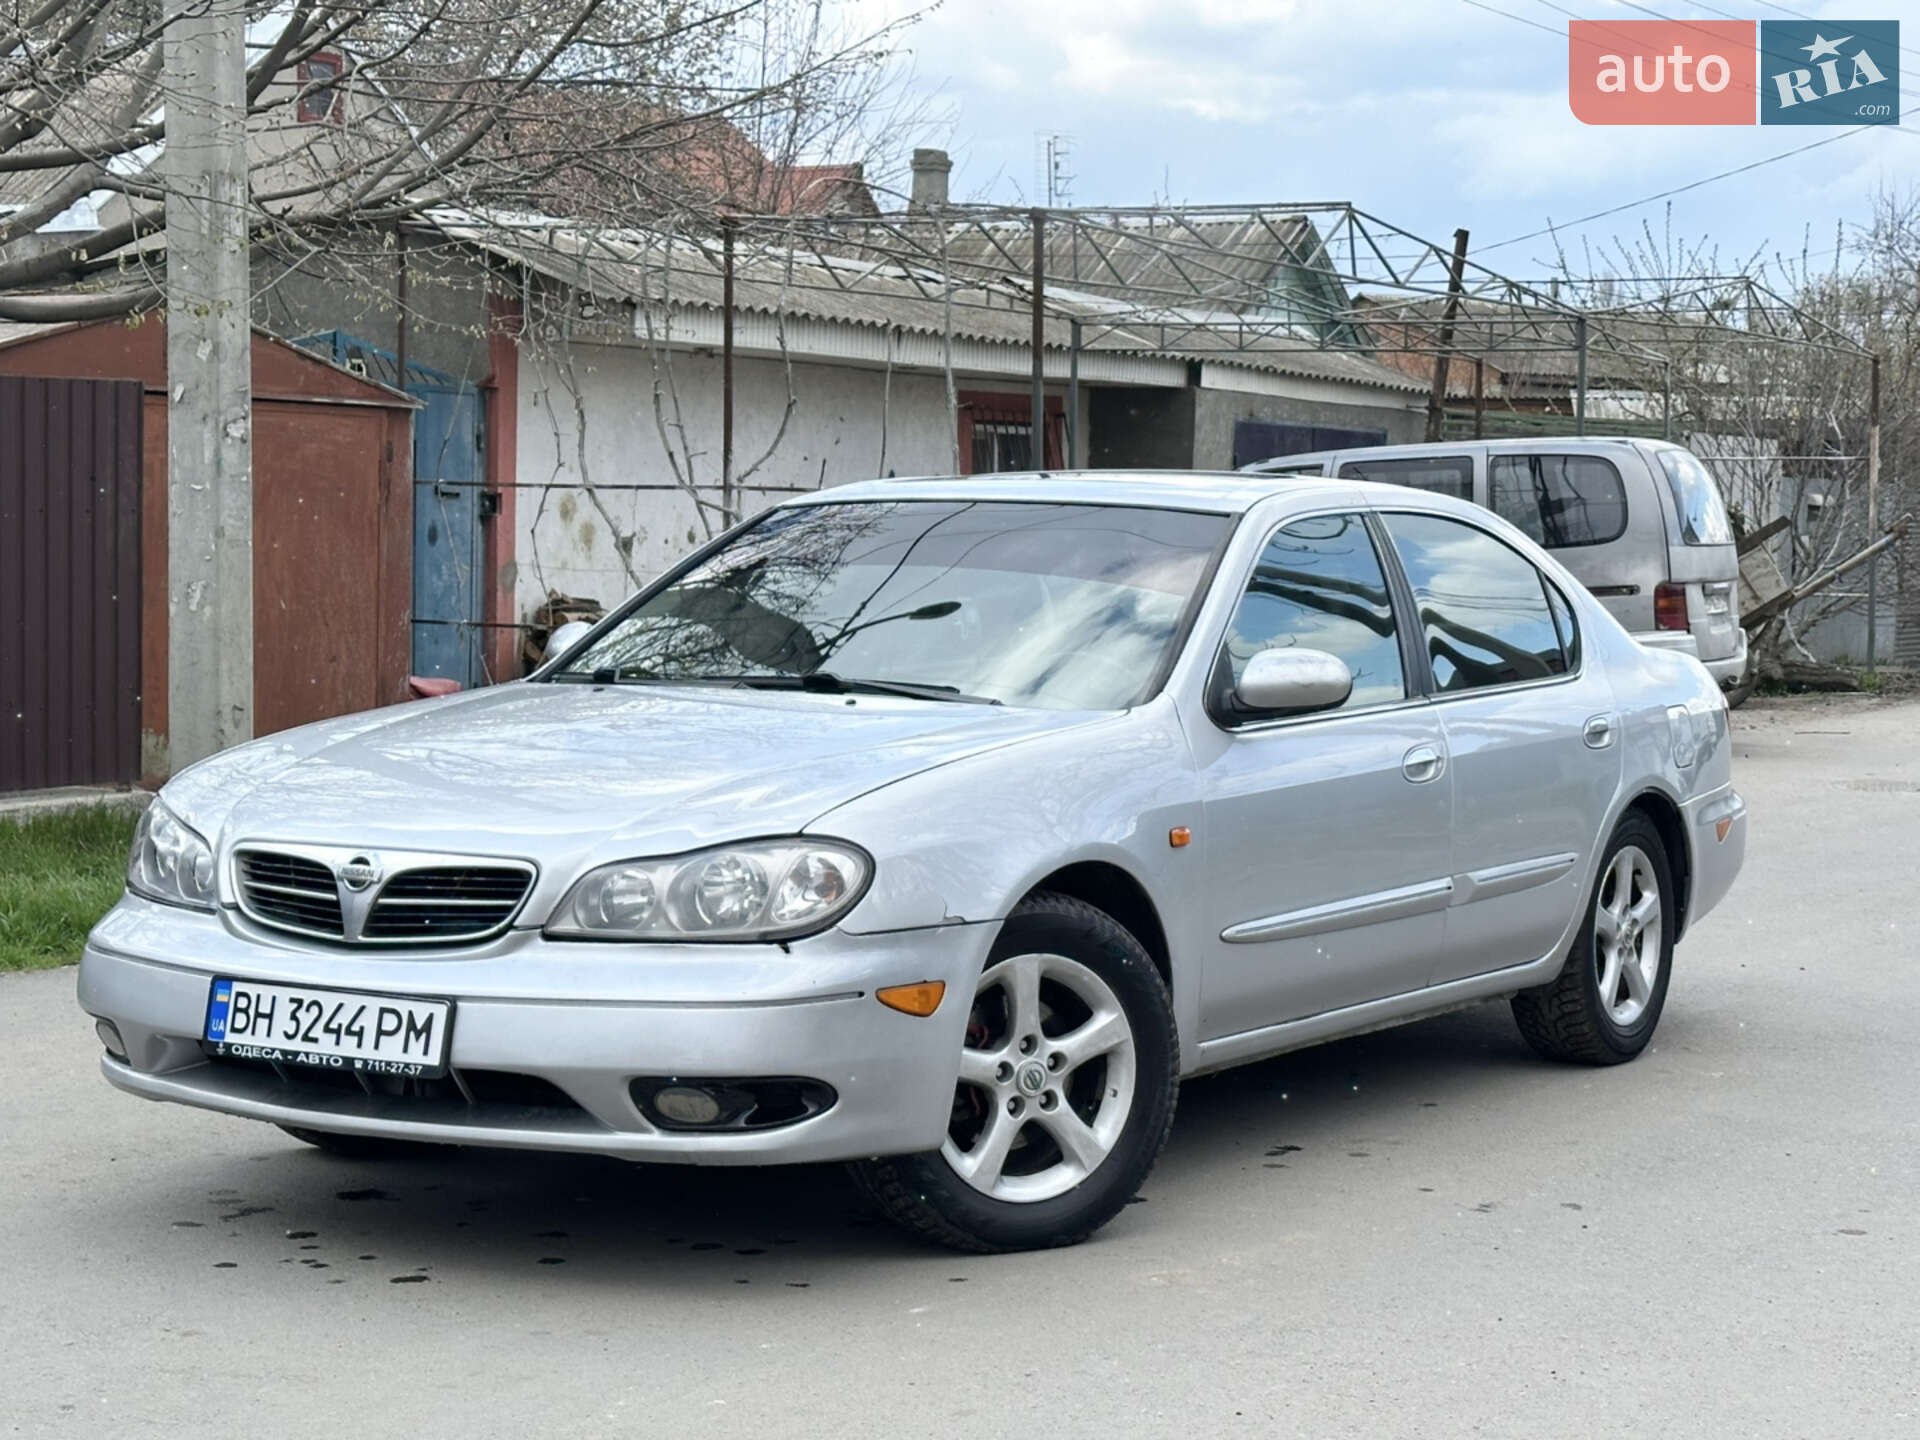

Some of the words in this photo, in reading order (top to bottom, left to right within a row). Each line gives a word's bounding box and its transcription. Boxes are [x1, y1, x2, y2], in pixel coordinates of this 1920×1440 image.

[211, 1019, 225, 1032] UA
[230, 991, 276, 1037] BH
[283, 997, 367, 1048] 3244
[373, 1006, 434, 1056] PM
[231, 1044, 283, 1060] ОДЕСА
[296, 1052, 343, 1067] АВТО
[367, 1060, 423, 1076] 711-27-37
